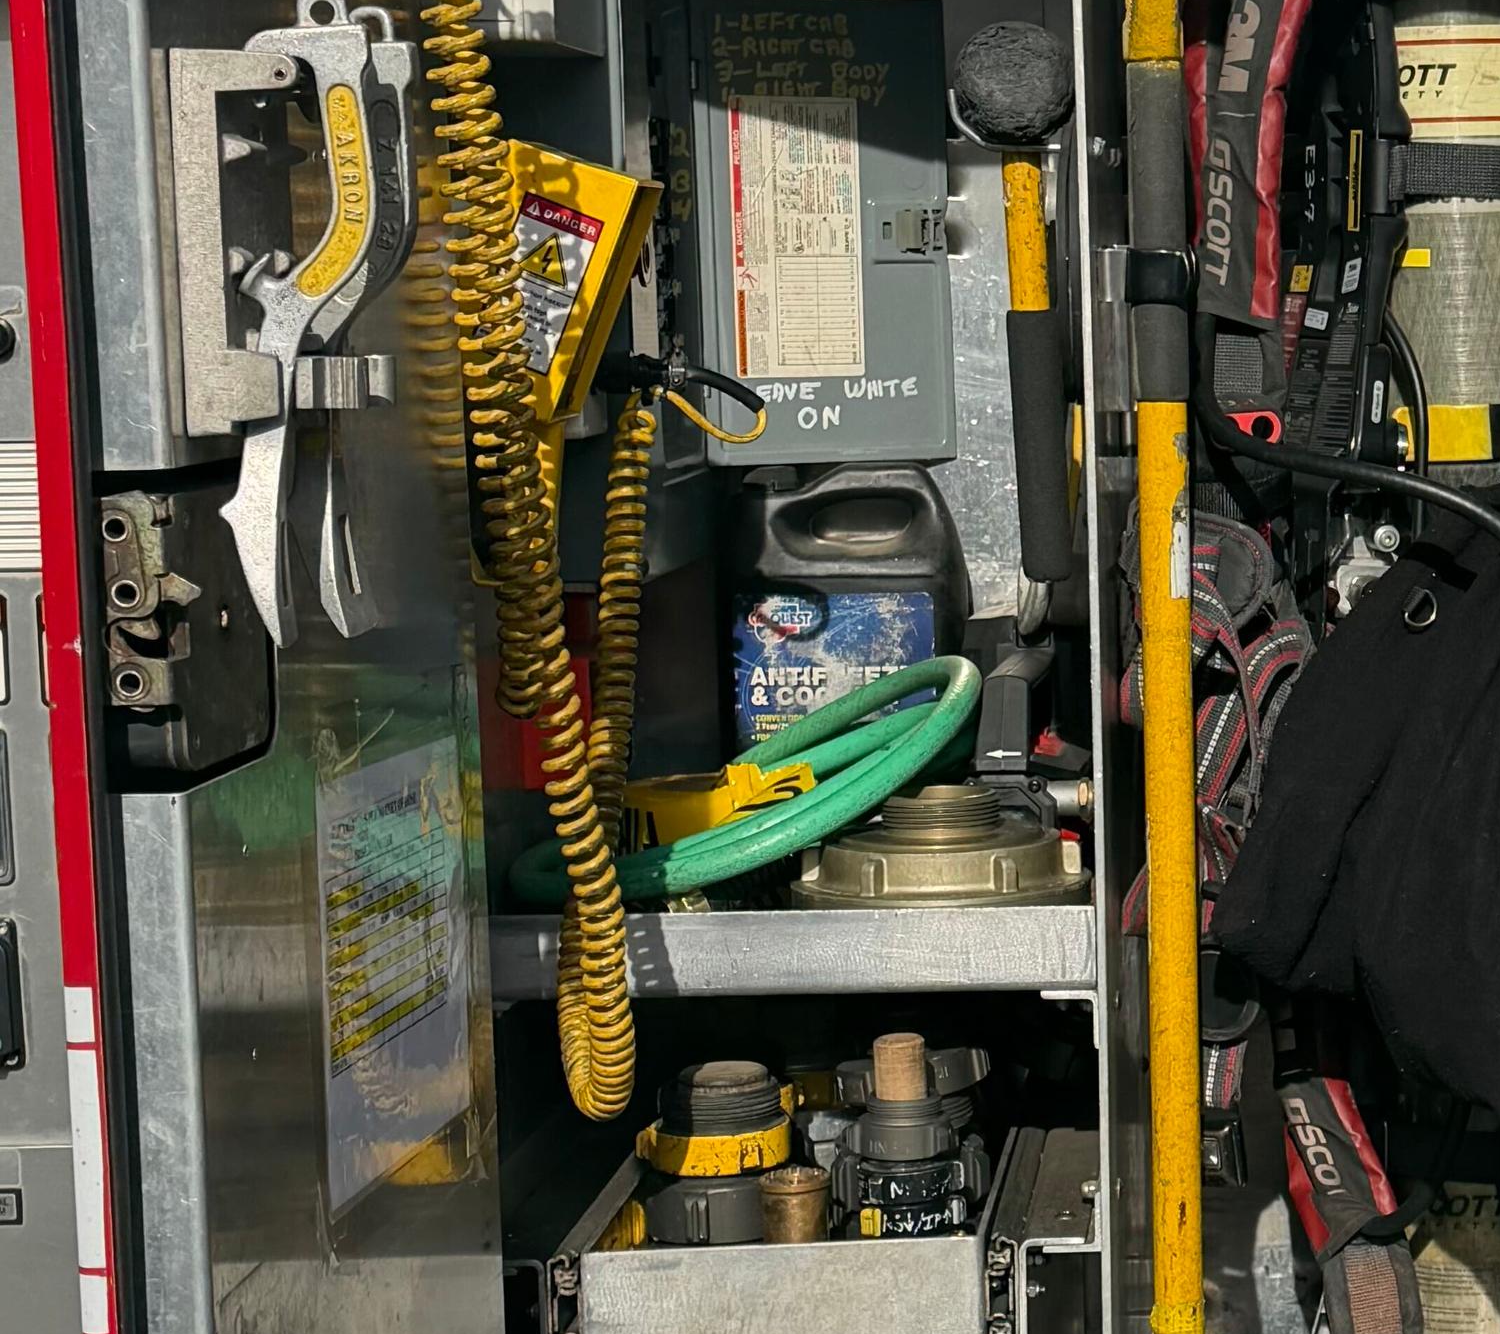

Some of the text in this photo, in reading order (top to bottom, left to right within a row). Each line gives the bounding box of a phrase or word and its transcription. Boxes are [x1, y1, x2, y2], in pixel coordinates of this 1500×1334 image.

[1217, 0, 1262, 93] 3M
[1400, 64, 1457, 87] OTT
[336, 131, 364, 225] AKRON
[543, 209, 597, 237] DANGER
[756, 376, 918, 403] EAVE WHITE
[797, 405, 841, 430] ON
